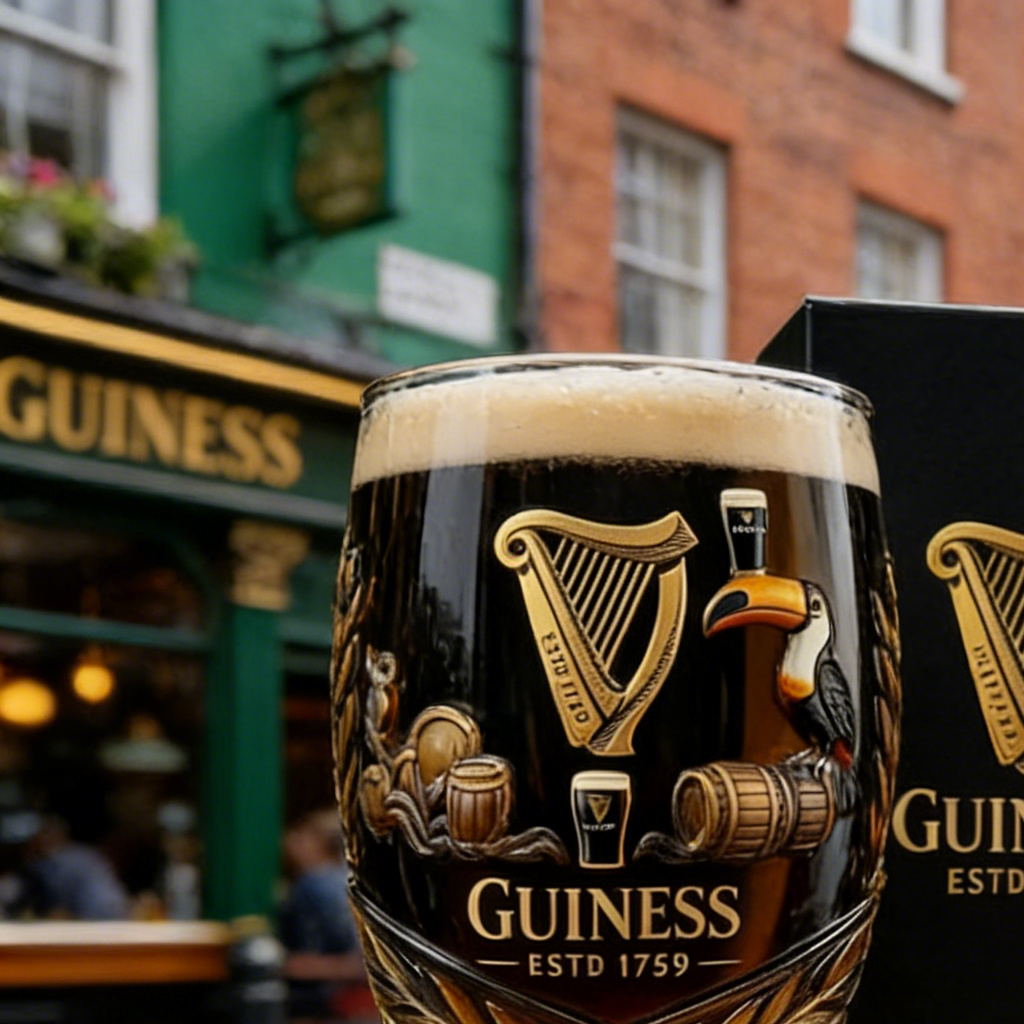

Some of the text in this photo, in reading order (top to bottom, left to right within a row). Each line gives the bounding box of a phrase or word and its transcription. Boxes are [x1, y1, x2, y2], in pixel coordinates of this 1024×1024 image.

[0, 355, 304, 489] GUINESS
[467, 877, 742, 941] GUINESS
[528, 953, 690, 977] ESTD 1759
